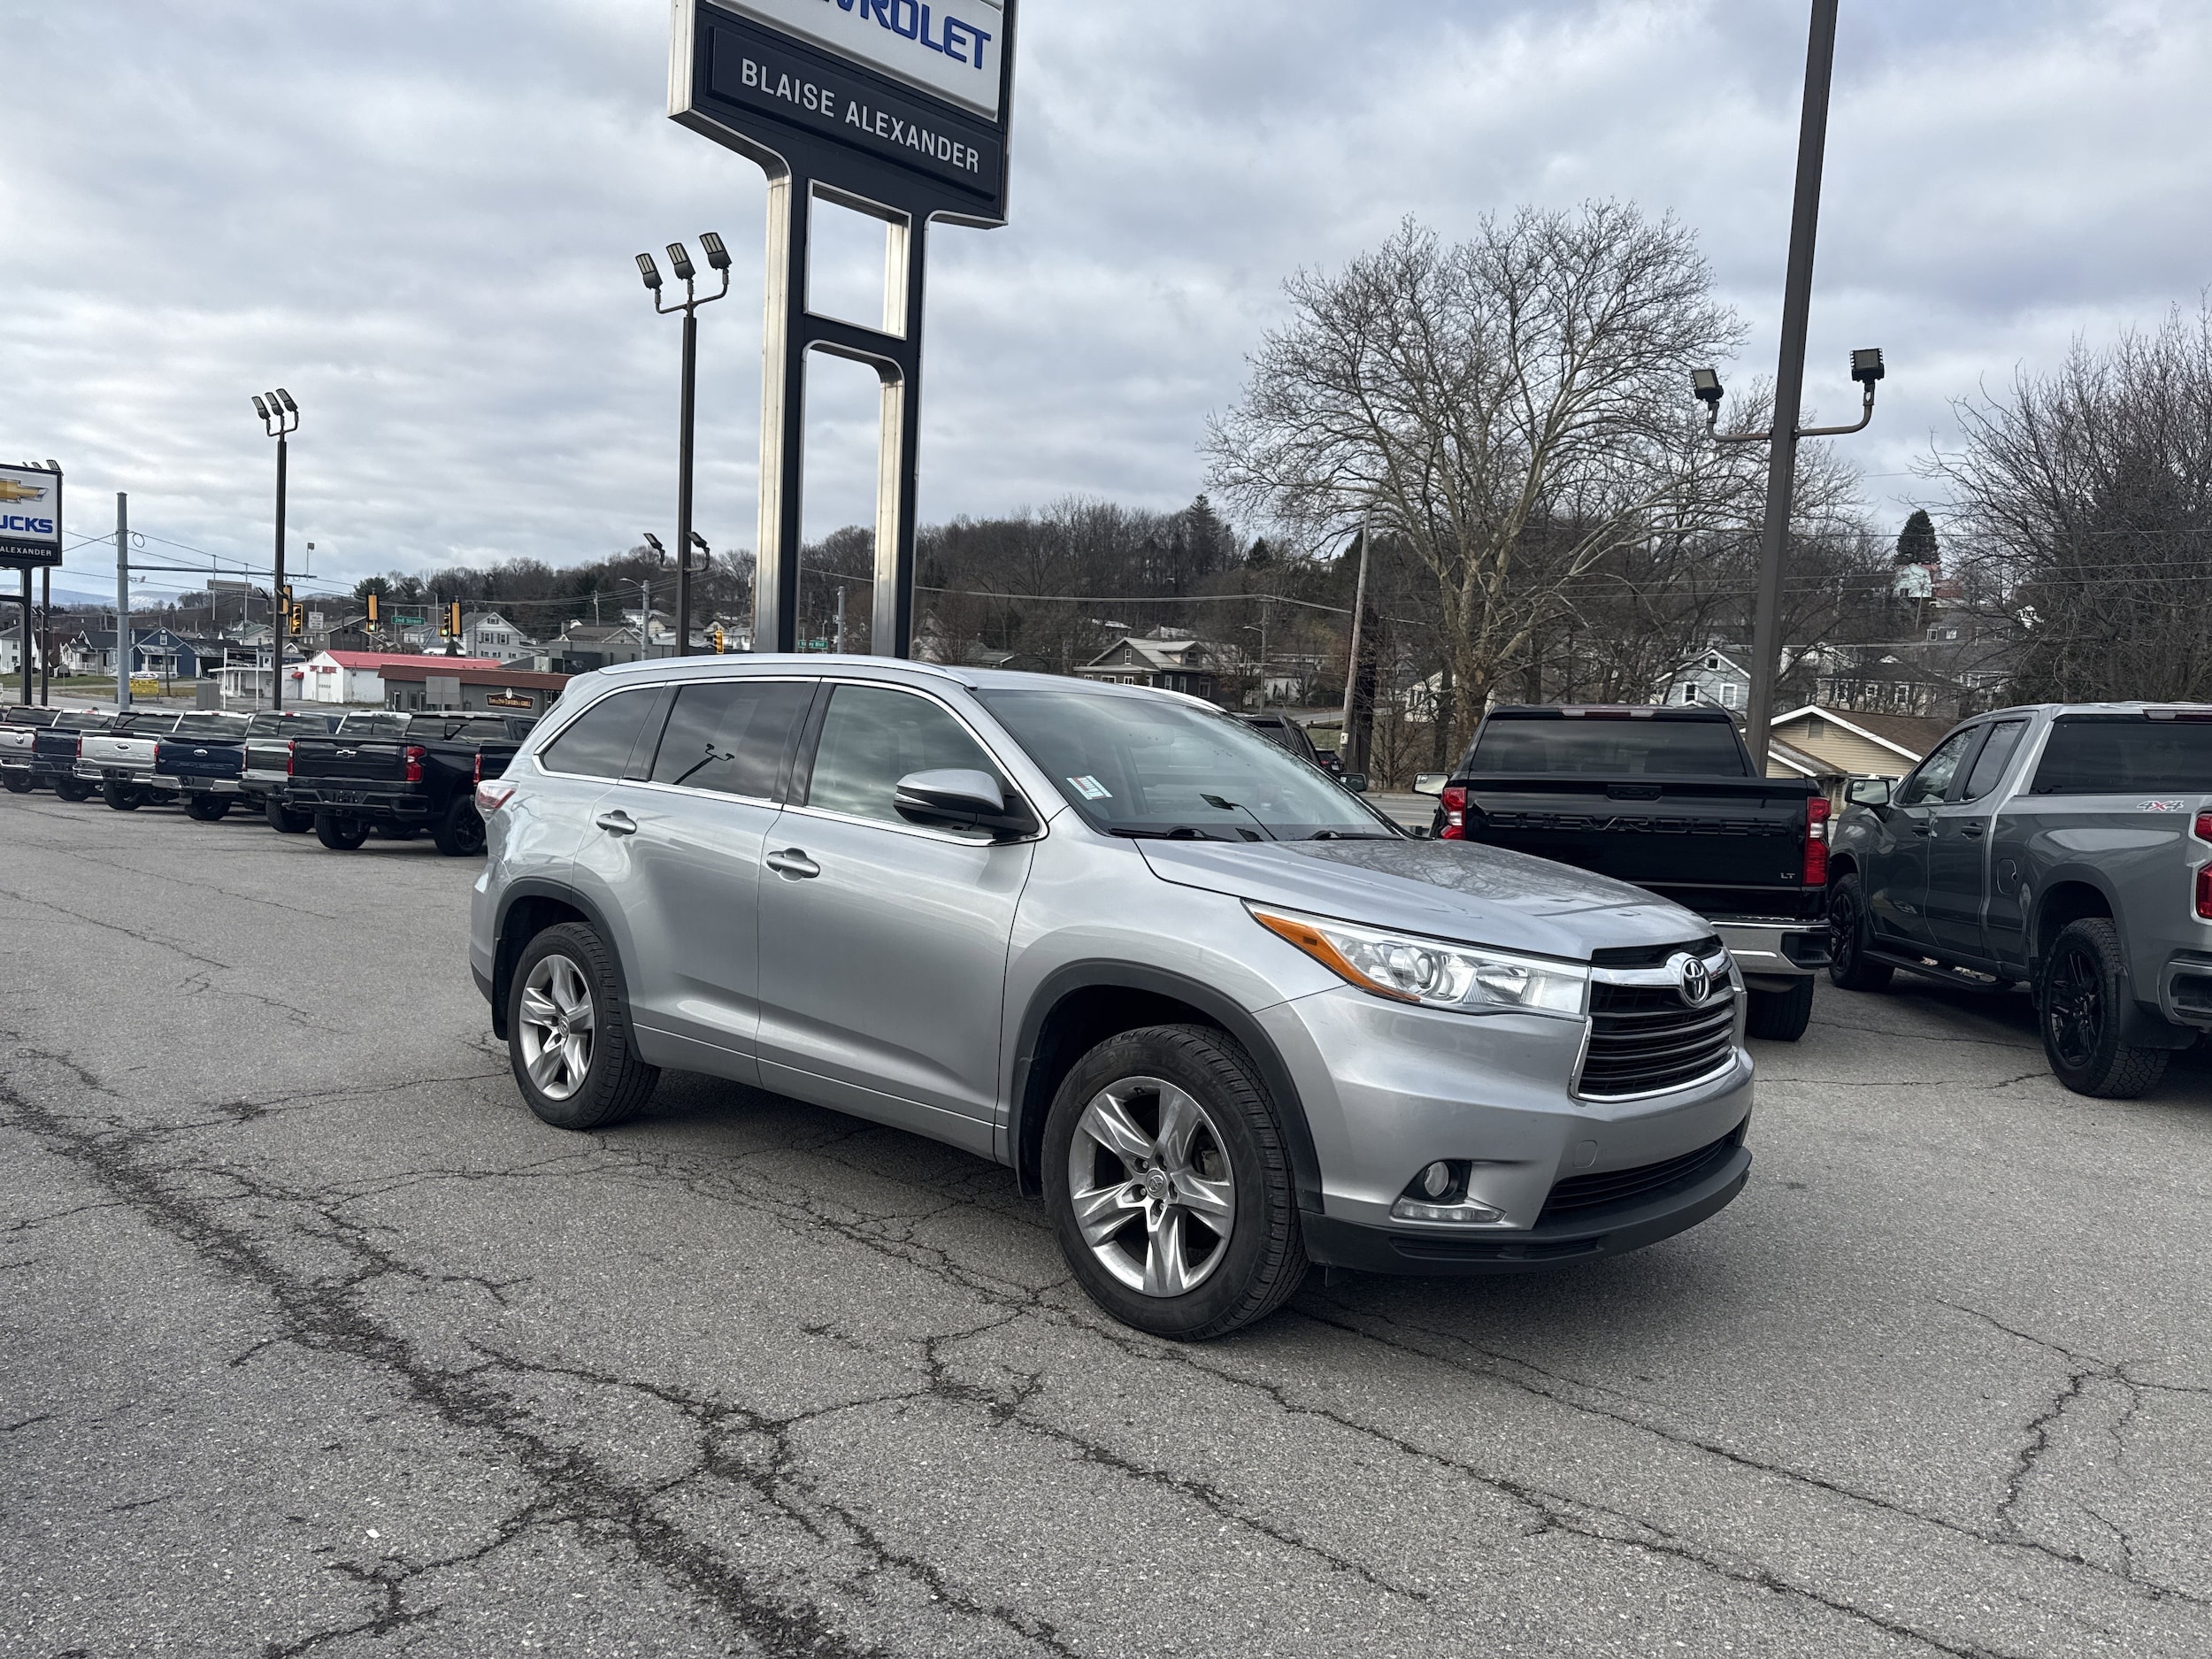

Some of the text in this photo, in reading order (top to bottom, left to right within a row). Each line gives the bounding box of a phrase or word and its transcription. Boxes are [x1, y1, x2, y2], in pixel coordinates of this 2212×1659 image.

[823, 0, 992, 70] ROLET
[741, 58, 979, 173] BLAISE ALEXANDER
[0, 545, 52, 557] ALEXANDER
[1487, 811, 1787, 837] CHEVROLET
